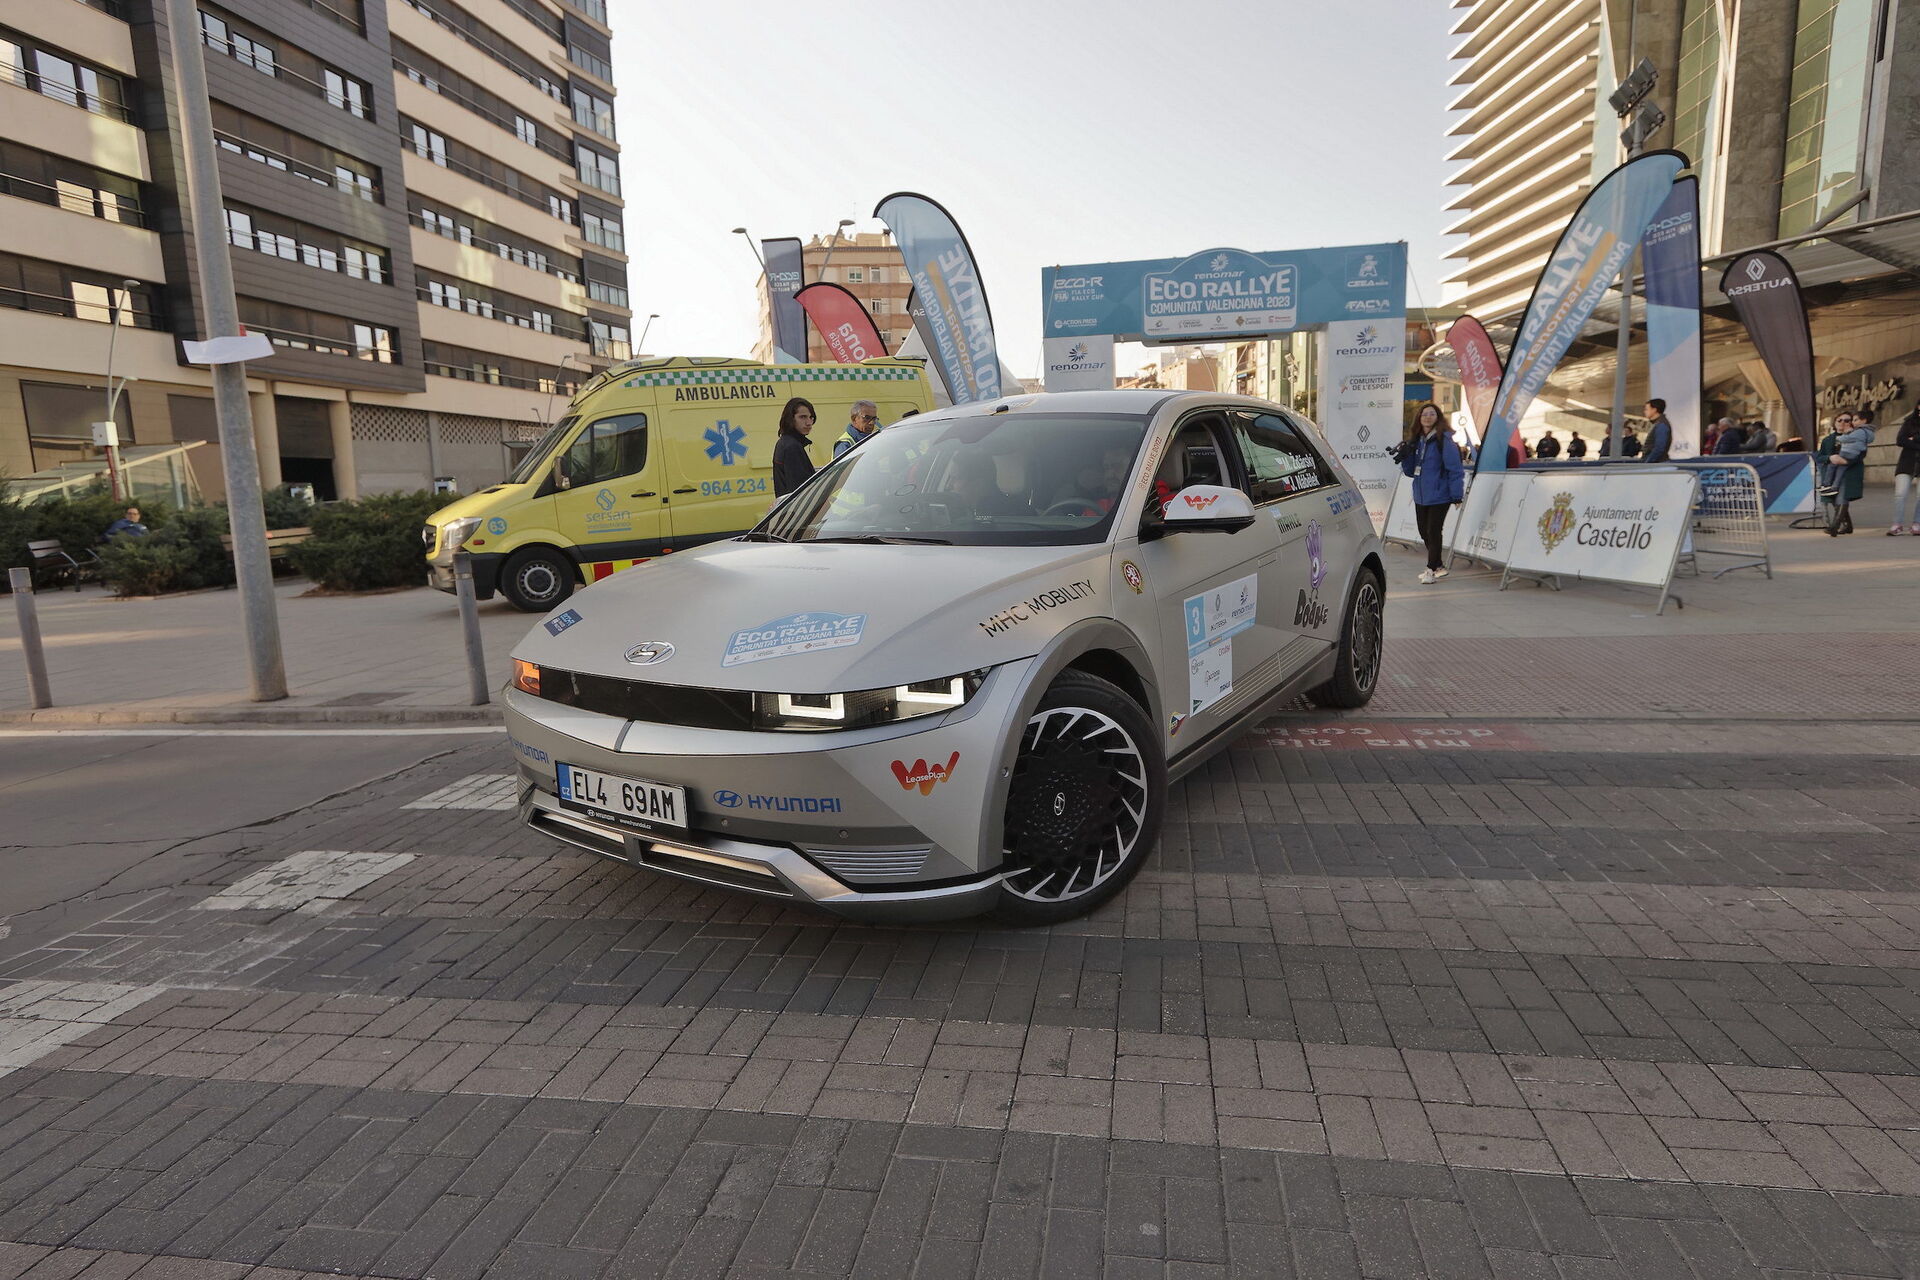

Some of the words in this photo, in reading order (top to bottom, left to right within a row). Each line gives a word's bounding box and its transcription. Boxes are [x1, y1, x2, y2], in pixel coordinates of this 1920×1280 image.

[1150, 277, 1197, 301] ECO
[1202, 268, 1292, 298] RALLYE
[1194, 271, 1244, 280] renomar
[1524, 217, 1603, 342] RALLYE
[1150, 300, 1202, 314] COMUNITAT
[1205, 296, 1264, 312] VALENCIANA
[1266, 295, 1291, 308] 2023
[1505, 340, 1564, 424] COMUNITAT
[1557, 241, 1632, 340] VALENCIANA
[1336, 345, 1397, 356] renomar
[1051, 362, 1106, 371] renomar
[675, 385, 776, 401] AMBULANCIA
[701, 480, 732, 497] 964
[736, 478, 767, 493] 234
[584, 510, 632, 522] sersan
[1582, 505, 1641, 523] Ajuntament
[1643, 506, 1660, 521] de
[490, 521, 504, 531] 63
[1577, 522, 1653, 550] Castelló
[979, 605, 1030, 638] MHC
[1024, 579, 1097, 615] MOBILITY
[734, 630, 776, 646] ECO
[780, 615, 862, 638] RALLYE
[1192, 606, 1200, 636] 3
[732, 638, 779, 654] COMUNITAT
[780, 631, 833, 645] VALENCIANA
[834, 627, 857, 637] 2023
[906, 771, 947, 784] LeasePlan
[561, 787, 571, 796] CZ
[573, 771, 607, 806] EL4
[622, 782, 676, 821] 69AM
[747, 794, 842, 813] HYUNDAI
